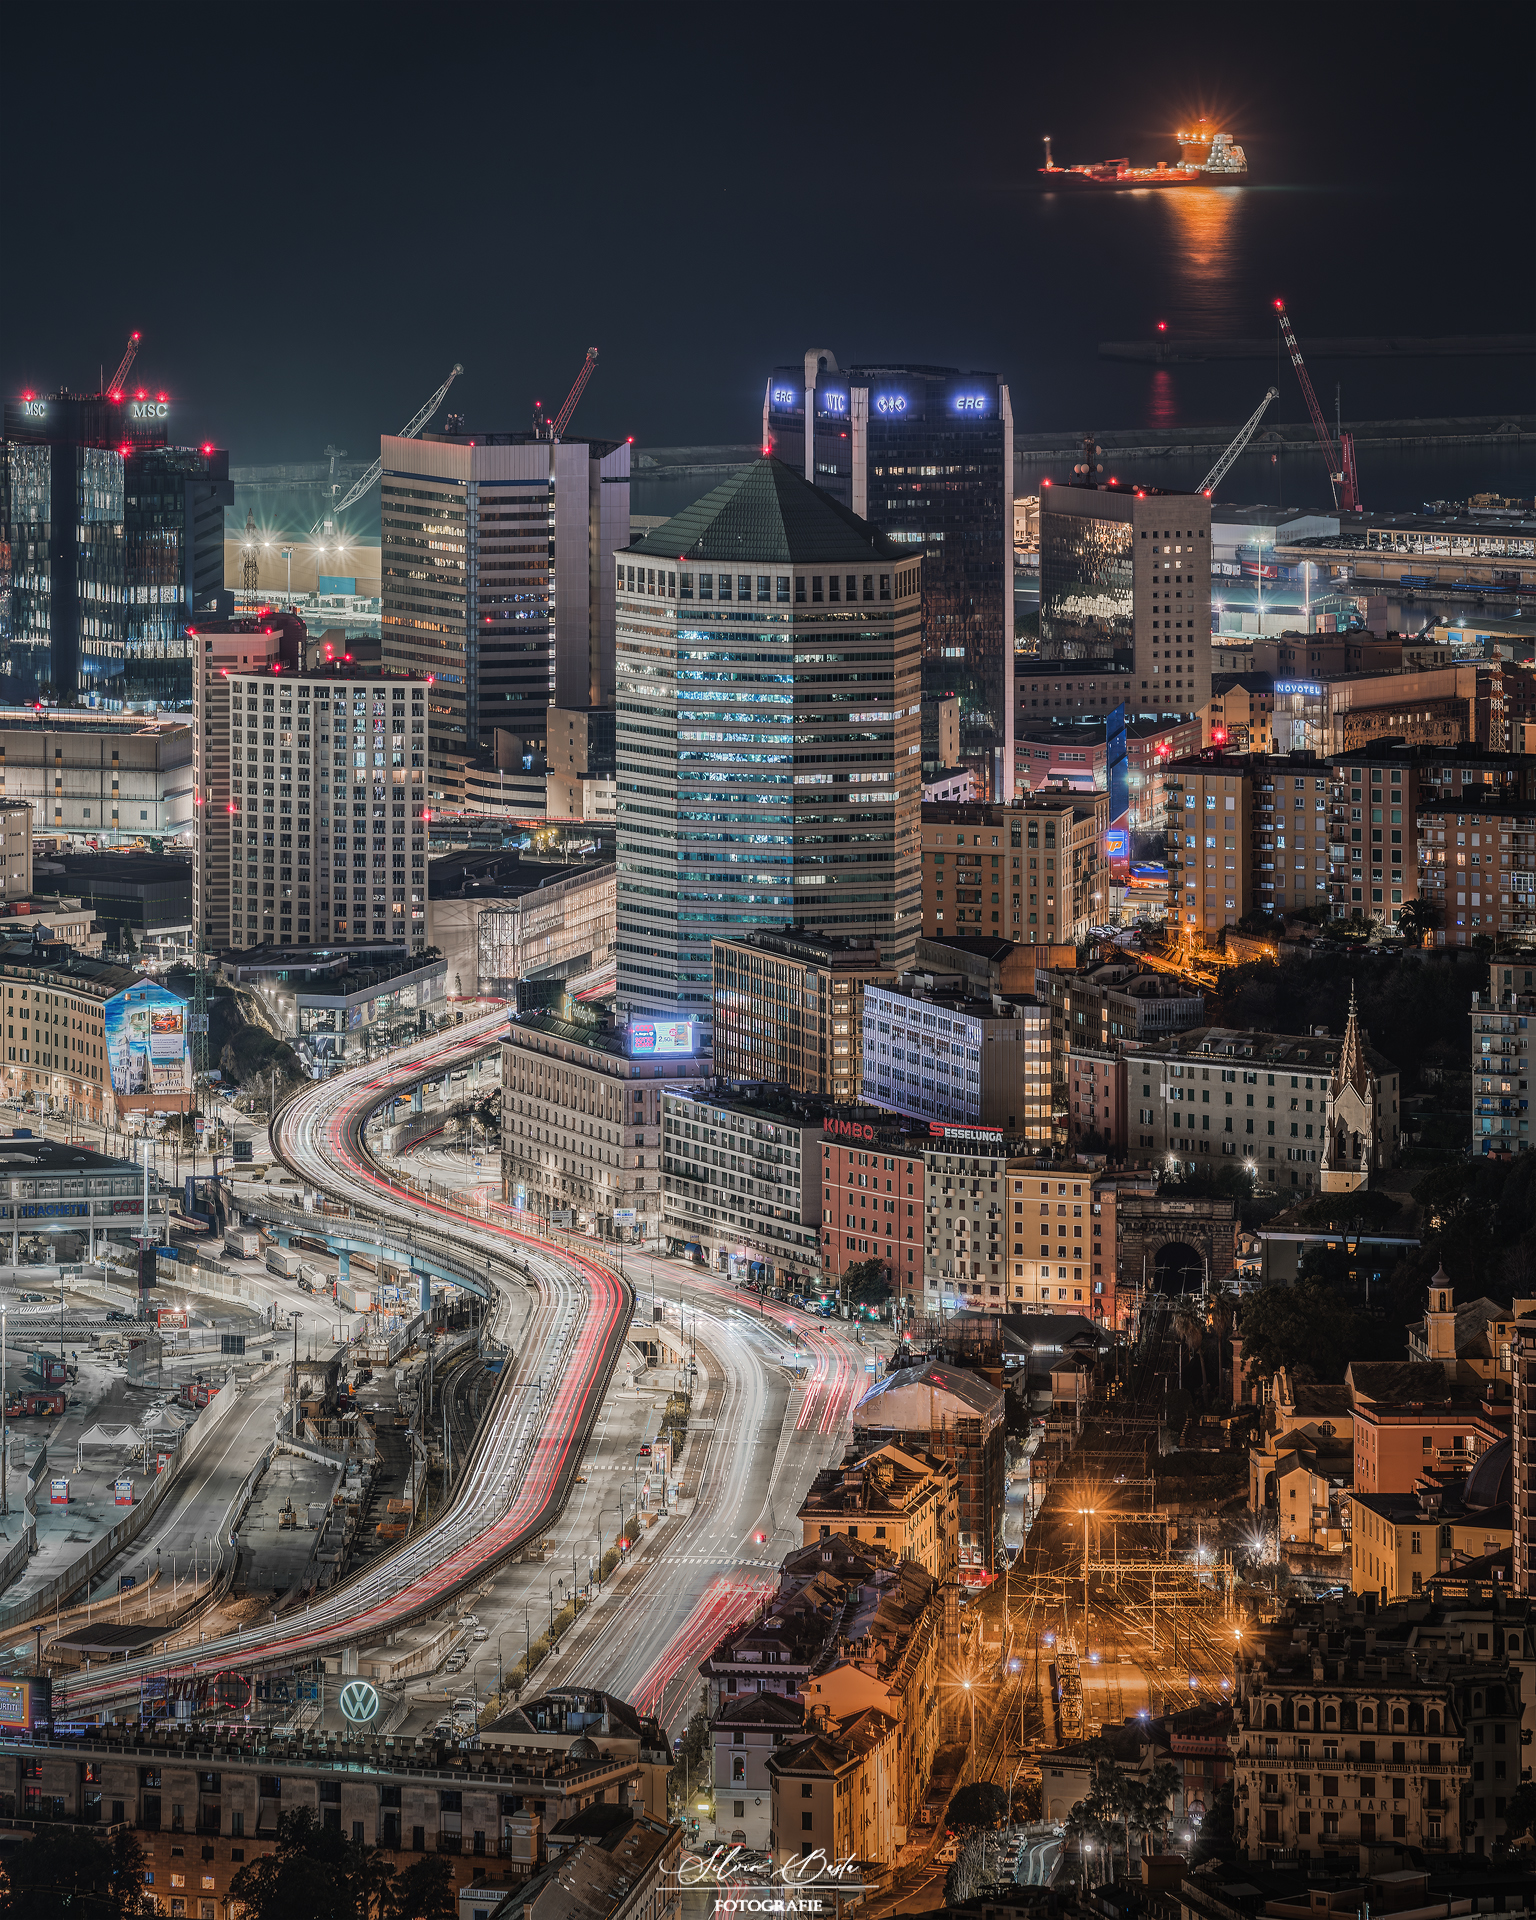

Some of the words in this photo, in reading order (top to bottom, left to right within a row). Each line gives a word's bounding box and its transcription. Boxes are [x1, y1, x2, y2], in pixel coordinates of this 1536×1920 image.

[774, 391, 792, 403] ERG
[827, 393, 844, 411] WTC
[956, 397, 984, 409] ERG
[25, 402, 46, 417] MSC
[133, 404, 168, 418] MSC
[1277, 684, 1320, 694] NOVOTEL
[823, 1117, 874, 1141] KIMBO
[21, 1204, 88, 1217] TRAGHETTI
[341, 1682, 378, 1721] VW
[1305, 1798, 1400, 1812] MIRAMARE
